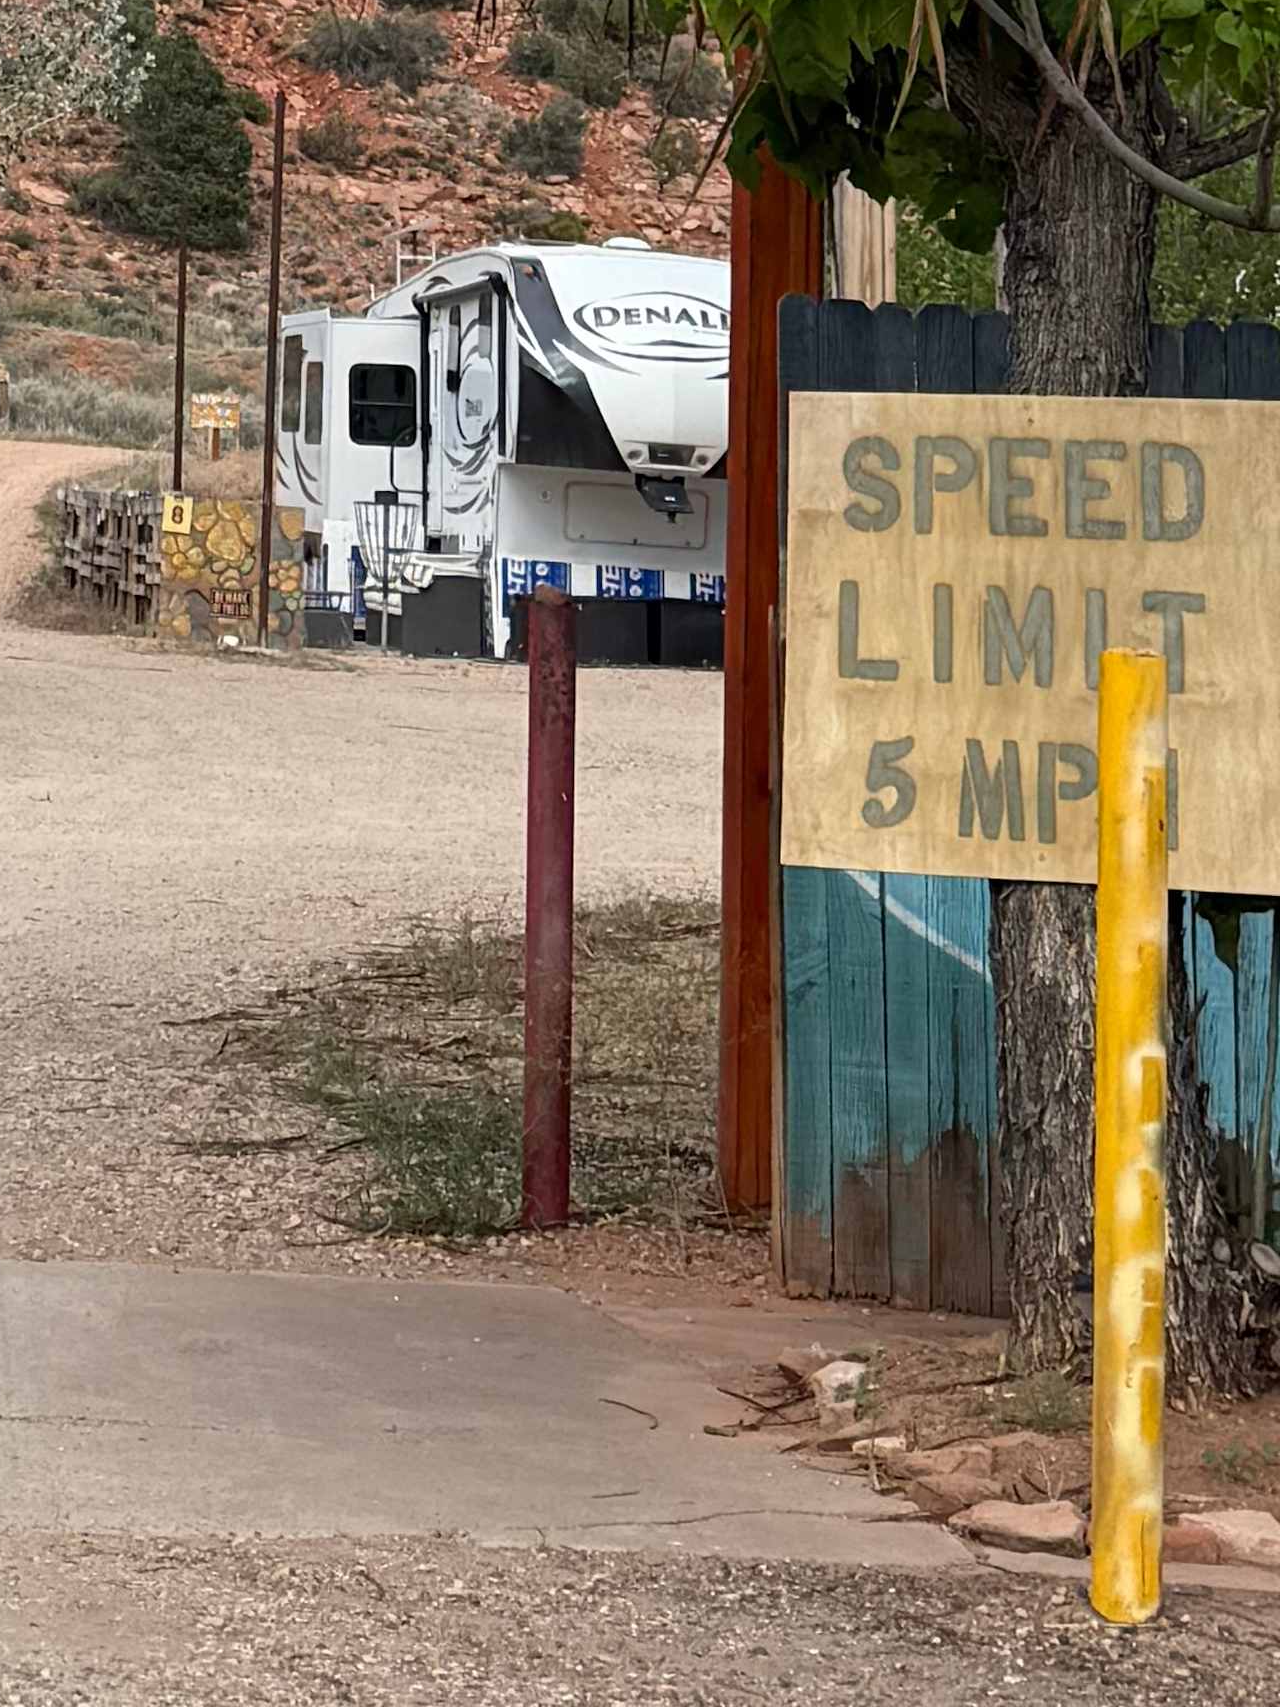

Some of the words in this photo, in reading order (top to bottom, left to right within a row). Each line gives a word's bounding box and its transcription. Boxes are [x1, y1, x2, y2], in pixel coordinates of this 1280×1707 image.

[593, 306, 730, 331] DENALI
[171, 505, 184, 524] 8
[842, 435, 1206, 542] SPEED
[839, 580, 1206, 694] LIMIT
[861, 735, 916, 828] 5
[958, 737, 1179, 851] MP
